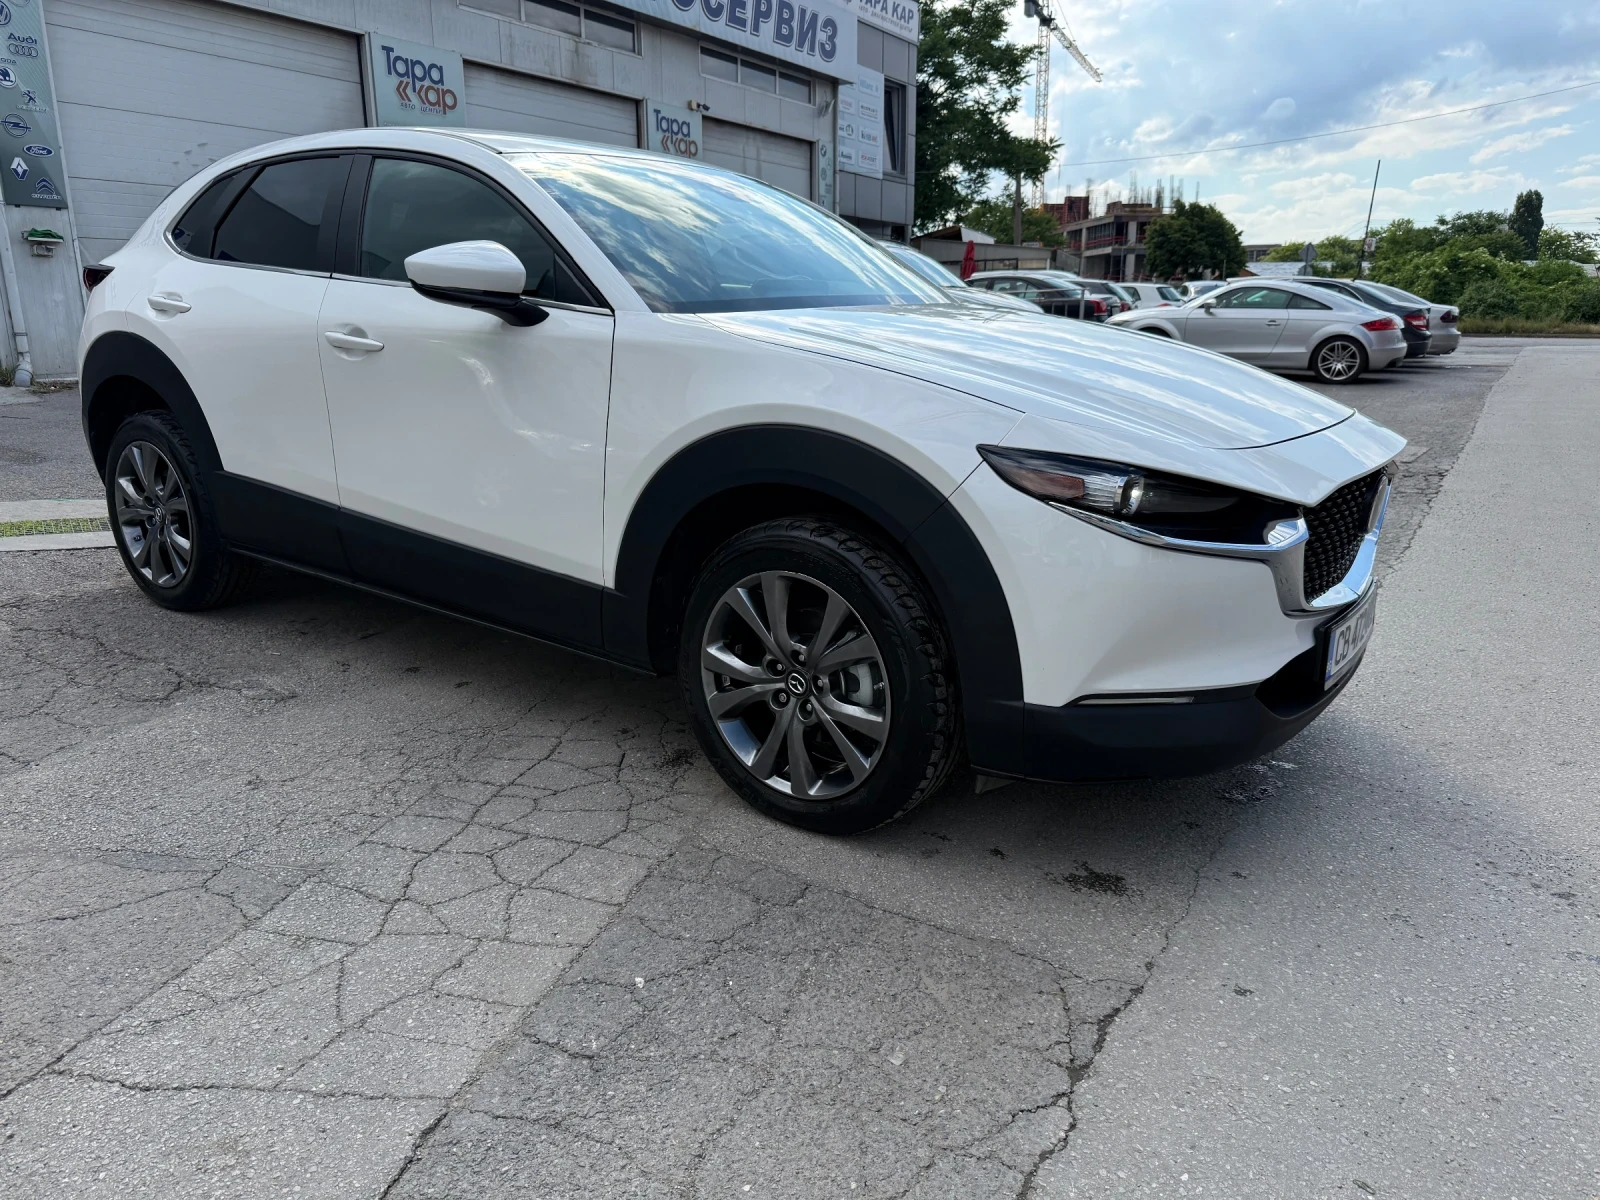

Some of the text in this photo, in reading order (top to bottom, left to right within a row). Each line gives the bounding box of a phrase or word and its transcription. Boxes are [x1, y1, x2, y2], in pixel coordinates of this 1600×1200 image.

[860, 0, 914, 25] РА КАР
[7, 32, 38, 44] Audi
[670, 0, 838, 62] ЕРВИЗ
[381, 45, 444, 93] Тара
[400, 102, 416, 110] АВТО
[653, 108, 690, 144] Тара
